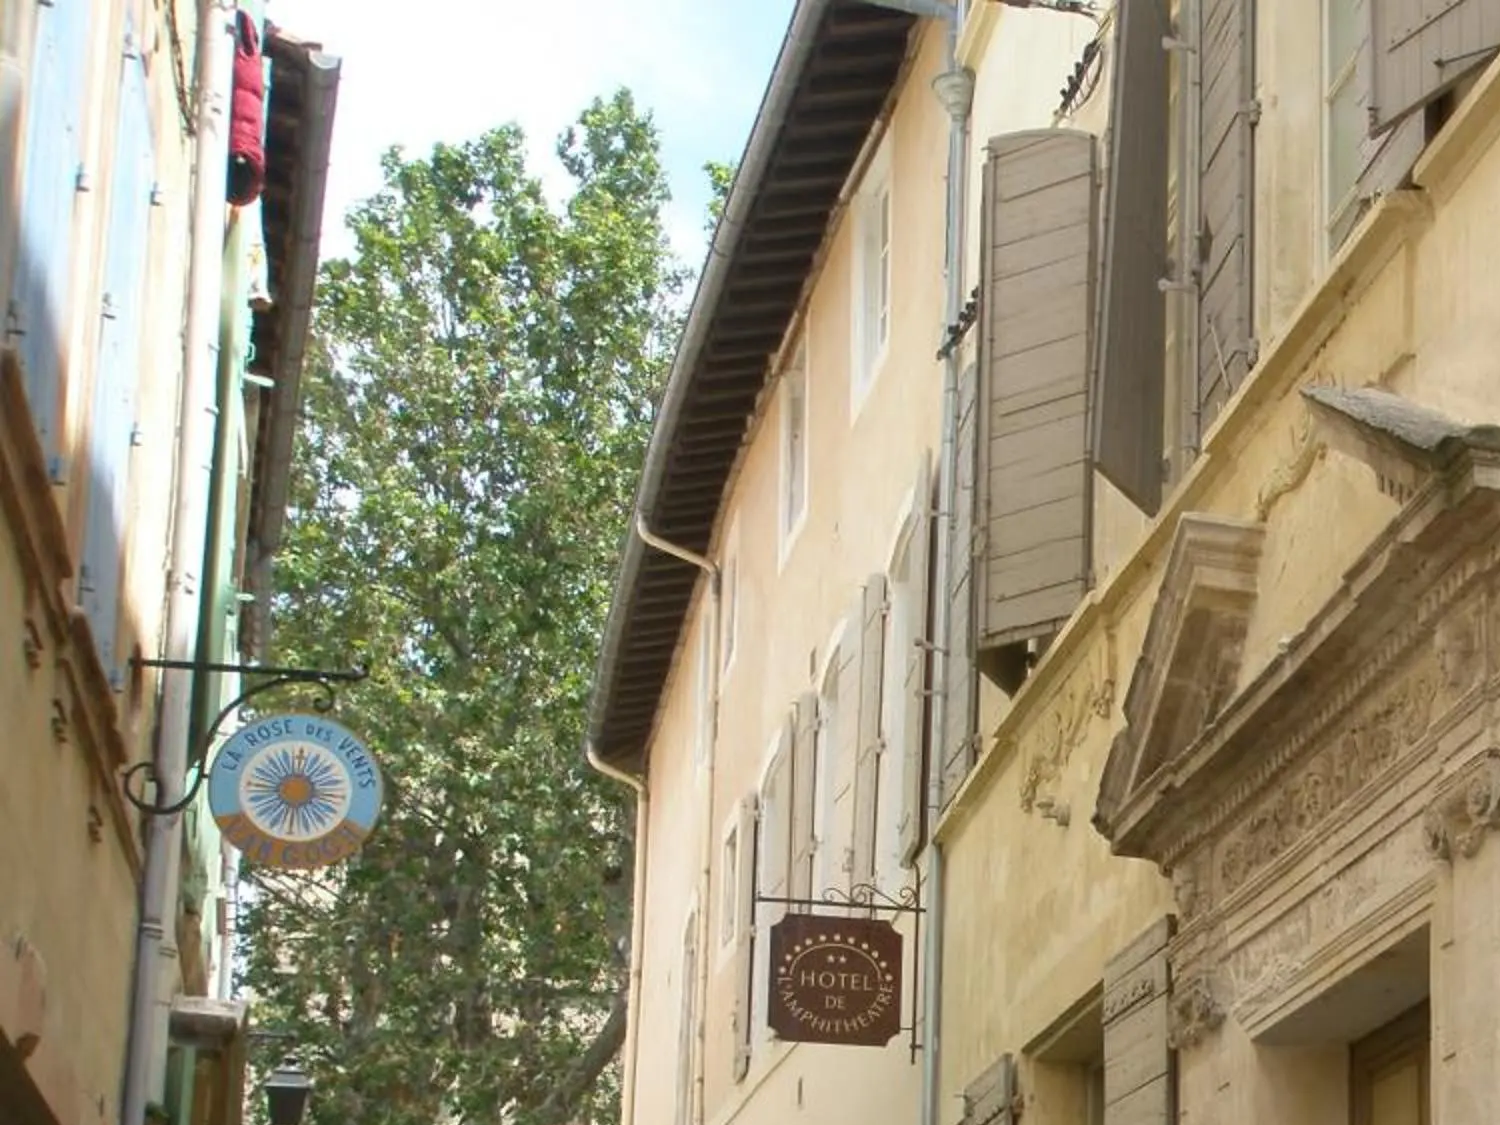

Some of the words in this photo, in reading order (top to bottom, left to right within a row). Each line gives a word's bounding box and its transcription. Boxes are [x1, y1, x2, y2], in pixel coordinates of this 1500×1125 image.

[221, 749, 243, 771] LA
[244, 719, 295, 750] ROSE
[305, 723, 334, 743] DES
[339, 737, 376, 788] VENTS
[800, 969, 874, 992] HOTEL
[825, 995, 847, 1010] DE
